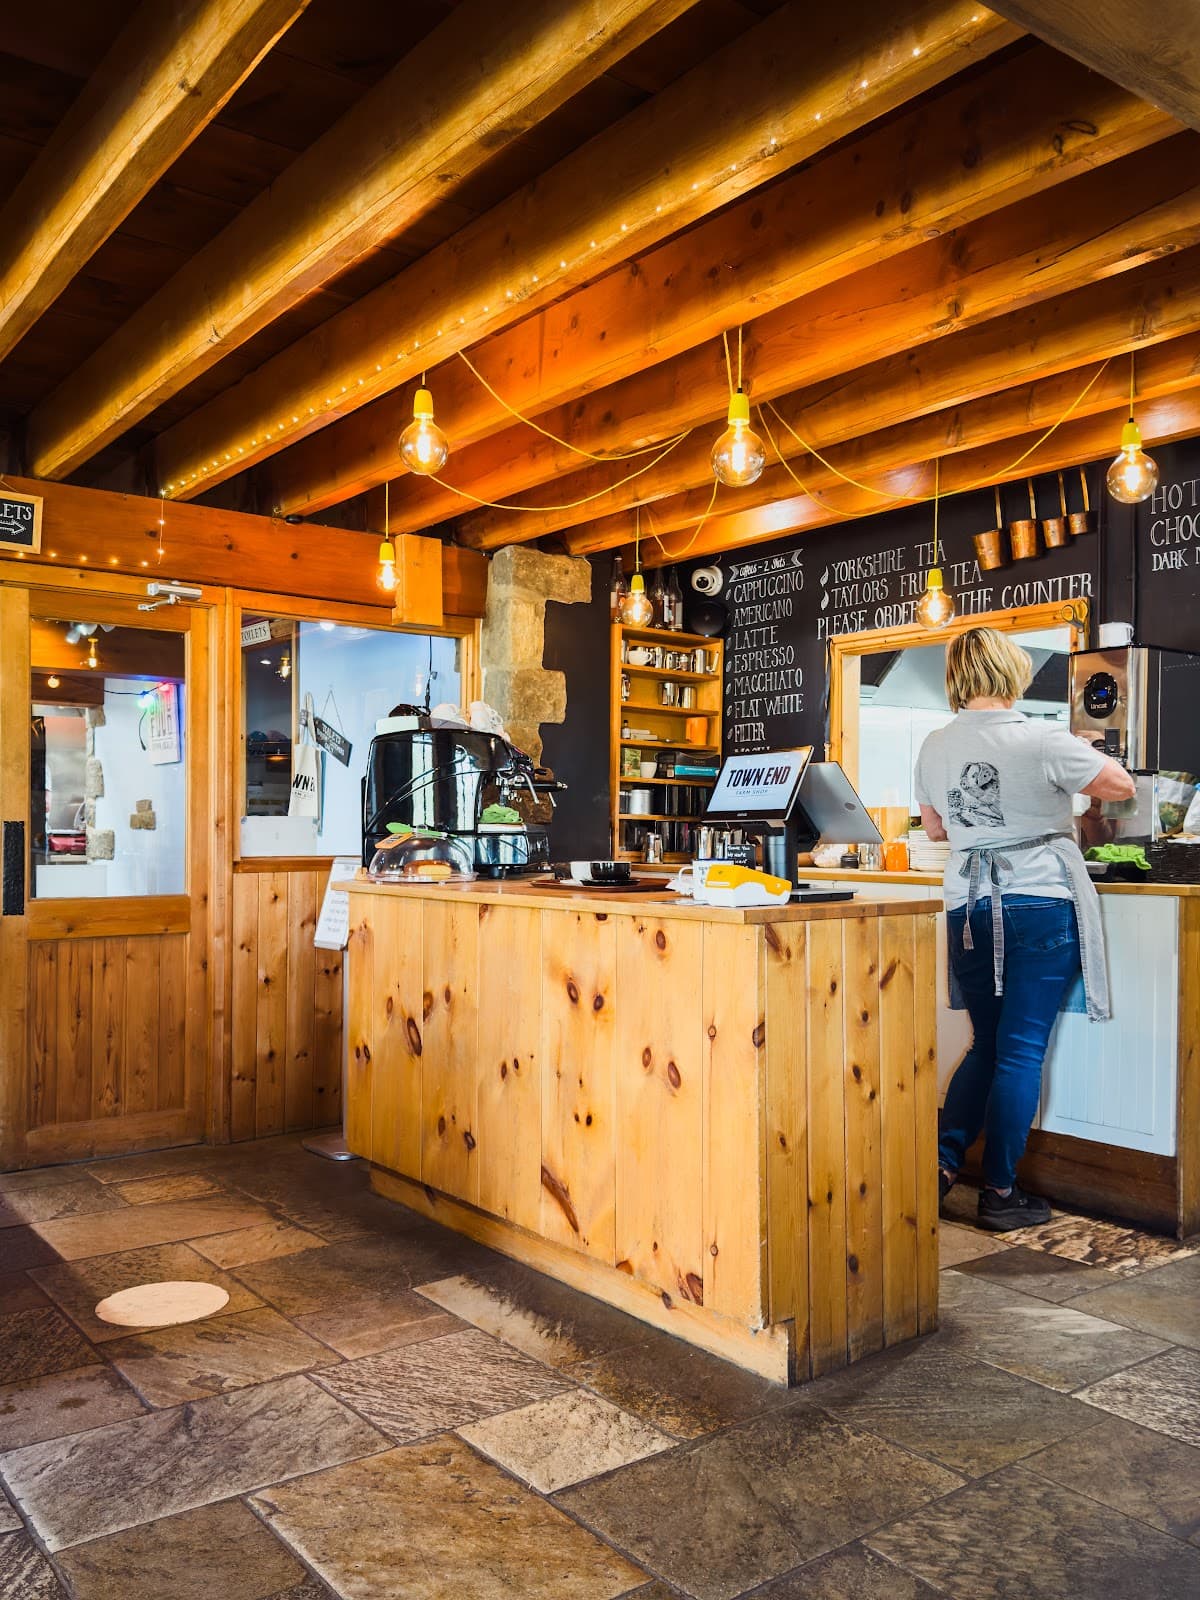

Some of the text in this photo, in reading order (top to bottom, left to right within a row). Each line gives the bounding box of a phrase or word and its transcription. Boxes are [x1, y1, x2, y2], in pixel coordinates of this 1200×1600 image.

[1151, 479, 1200, 514] HOT
[832, 540, 946, 583] YORKSHIRE TEA
[1152, 549, 1189, 571] DARK
[734, 570, 803, 603] CAPPUCCINO
[831, 560, 983, 608] TAYLORS FRU TEA
[733, 598, 793, 627] AMERICANO
[816, 609, 867, 640] PLEASE
[957, 588, 993, 616] THE
[1001, 572, 1094, 610] COUNTER
[735, 625, 778, 650] LATTE
[734, 645, 795, 673] ESPRESSO
[734, 668, 803, 696] MACCHIATO
[734, 694, 804, 718] FLAT WHITE
[734, 722, 766, 742] FILTER
[726, 765, 791, 787] TOWN END
